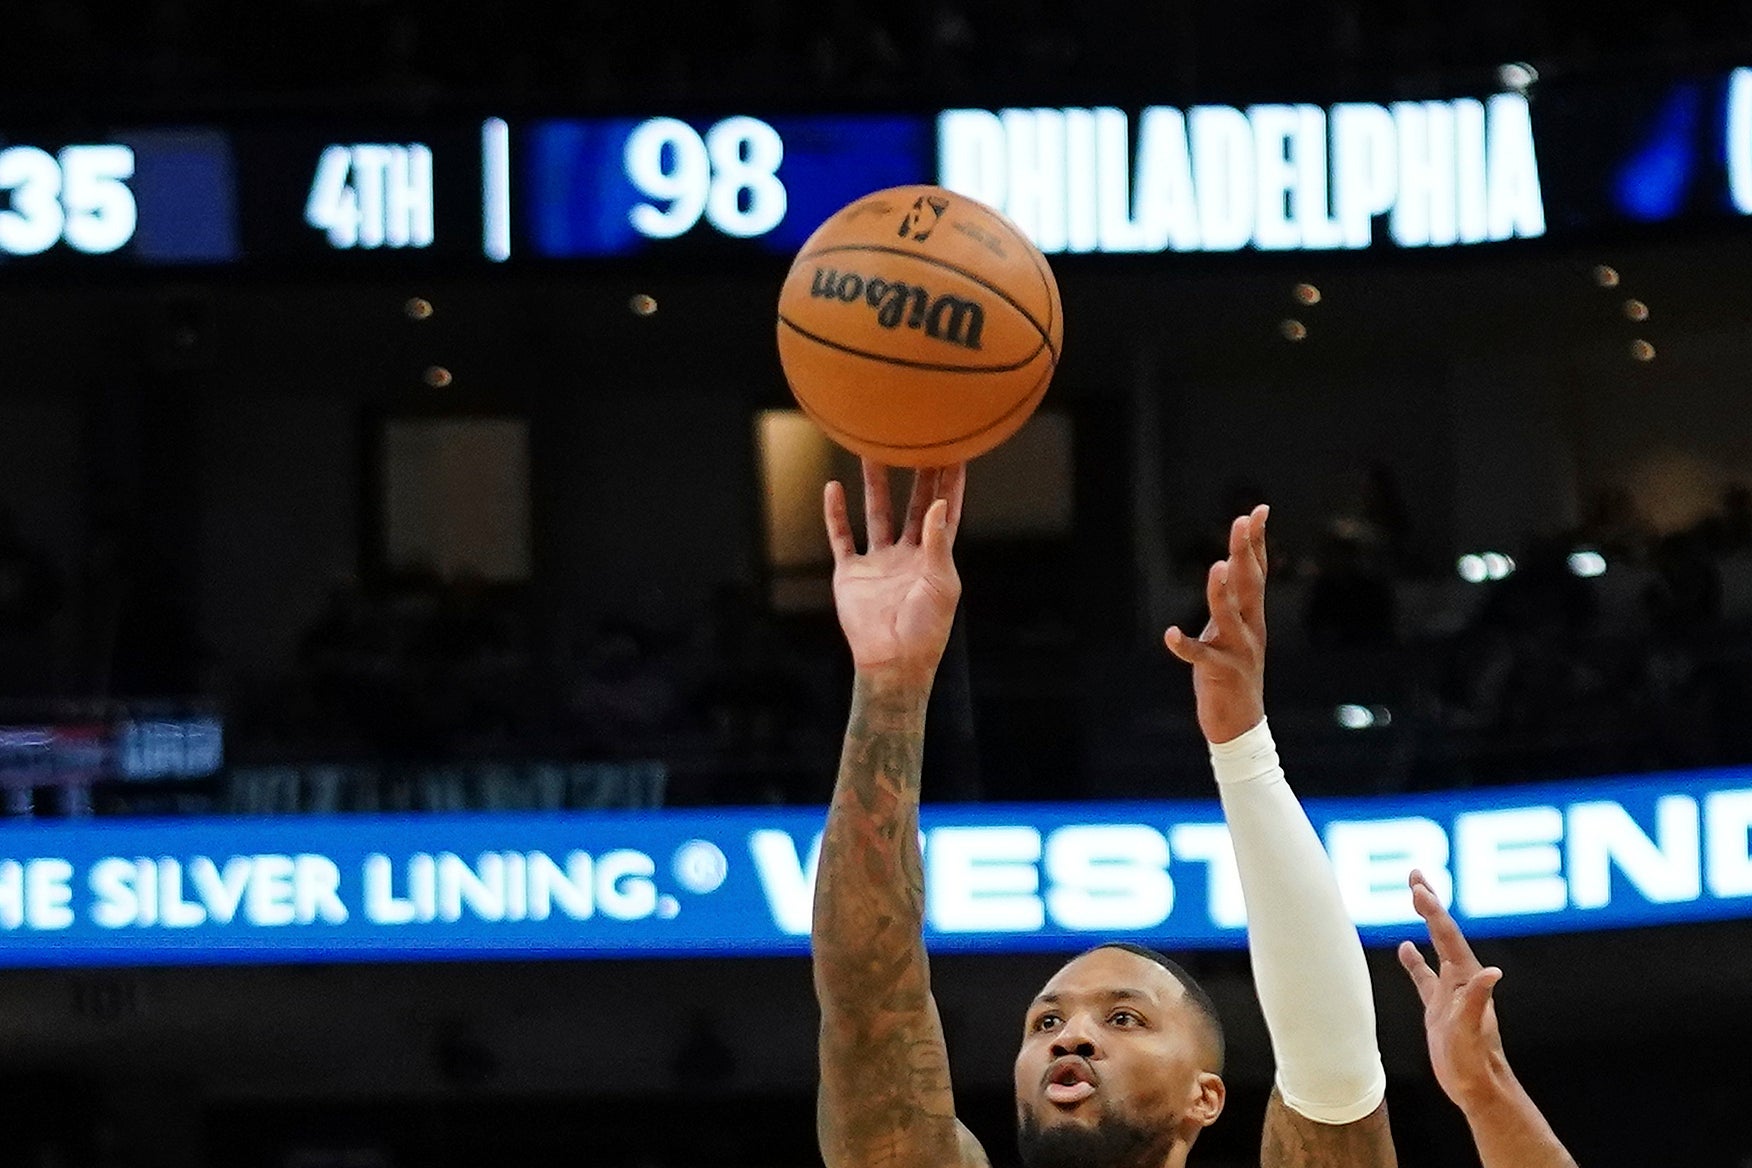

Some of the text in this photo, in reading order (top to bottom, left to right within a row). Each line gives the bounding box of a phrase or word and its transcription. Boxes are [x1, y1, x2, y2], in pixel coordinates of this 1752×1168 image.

[0, 145, 137, 254] 35
[307, 143, 434, 249] 4TH
[626, 92, 1546, 254] 98 PHILADELPHIA
[809, 266, 985, 352] Wilson
[91, 854, 349, 928] SILVER
